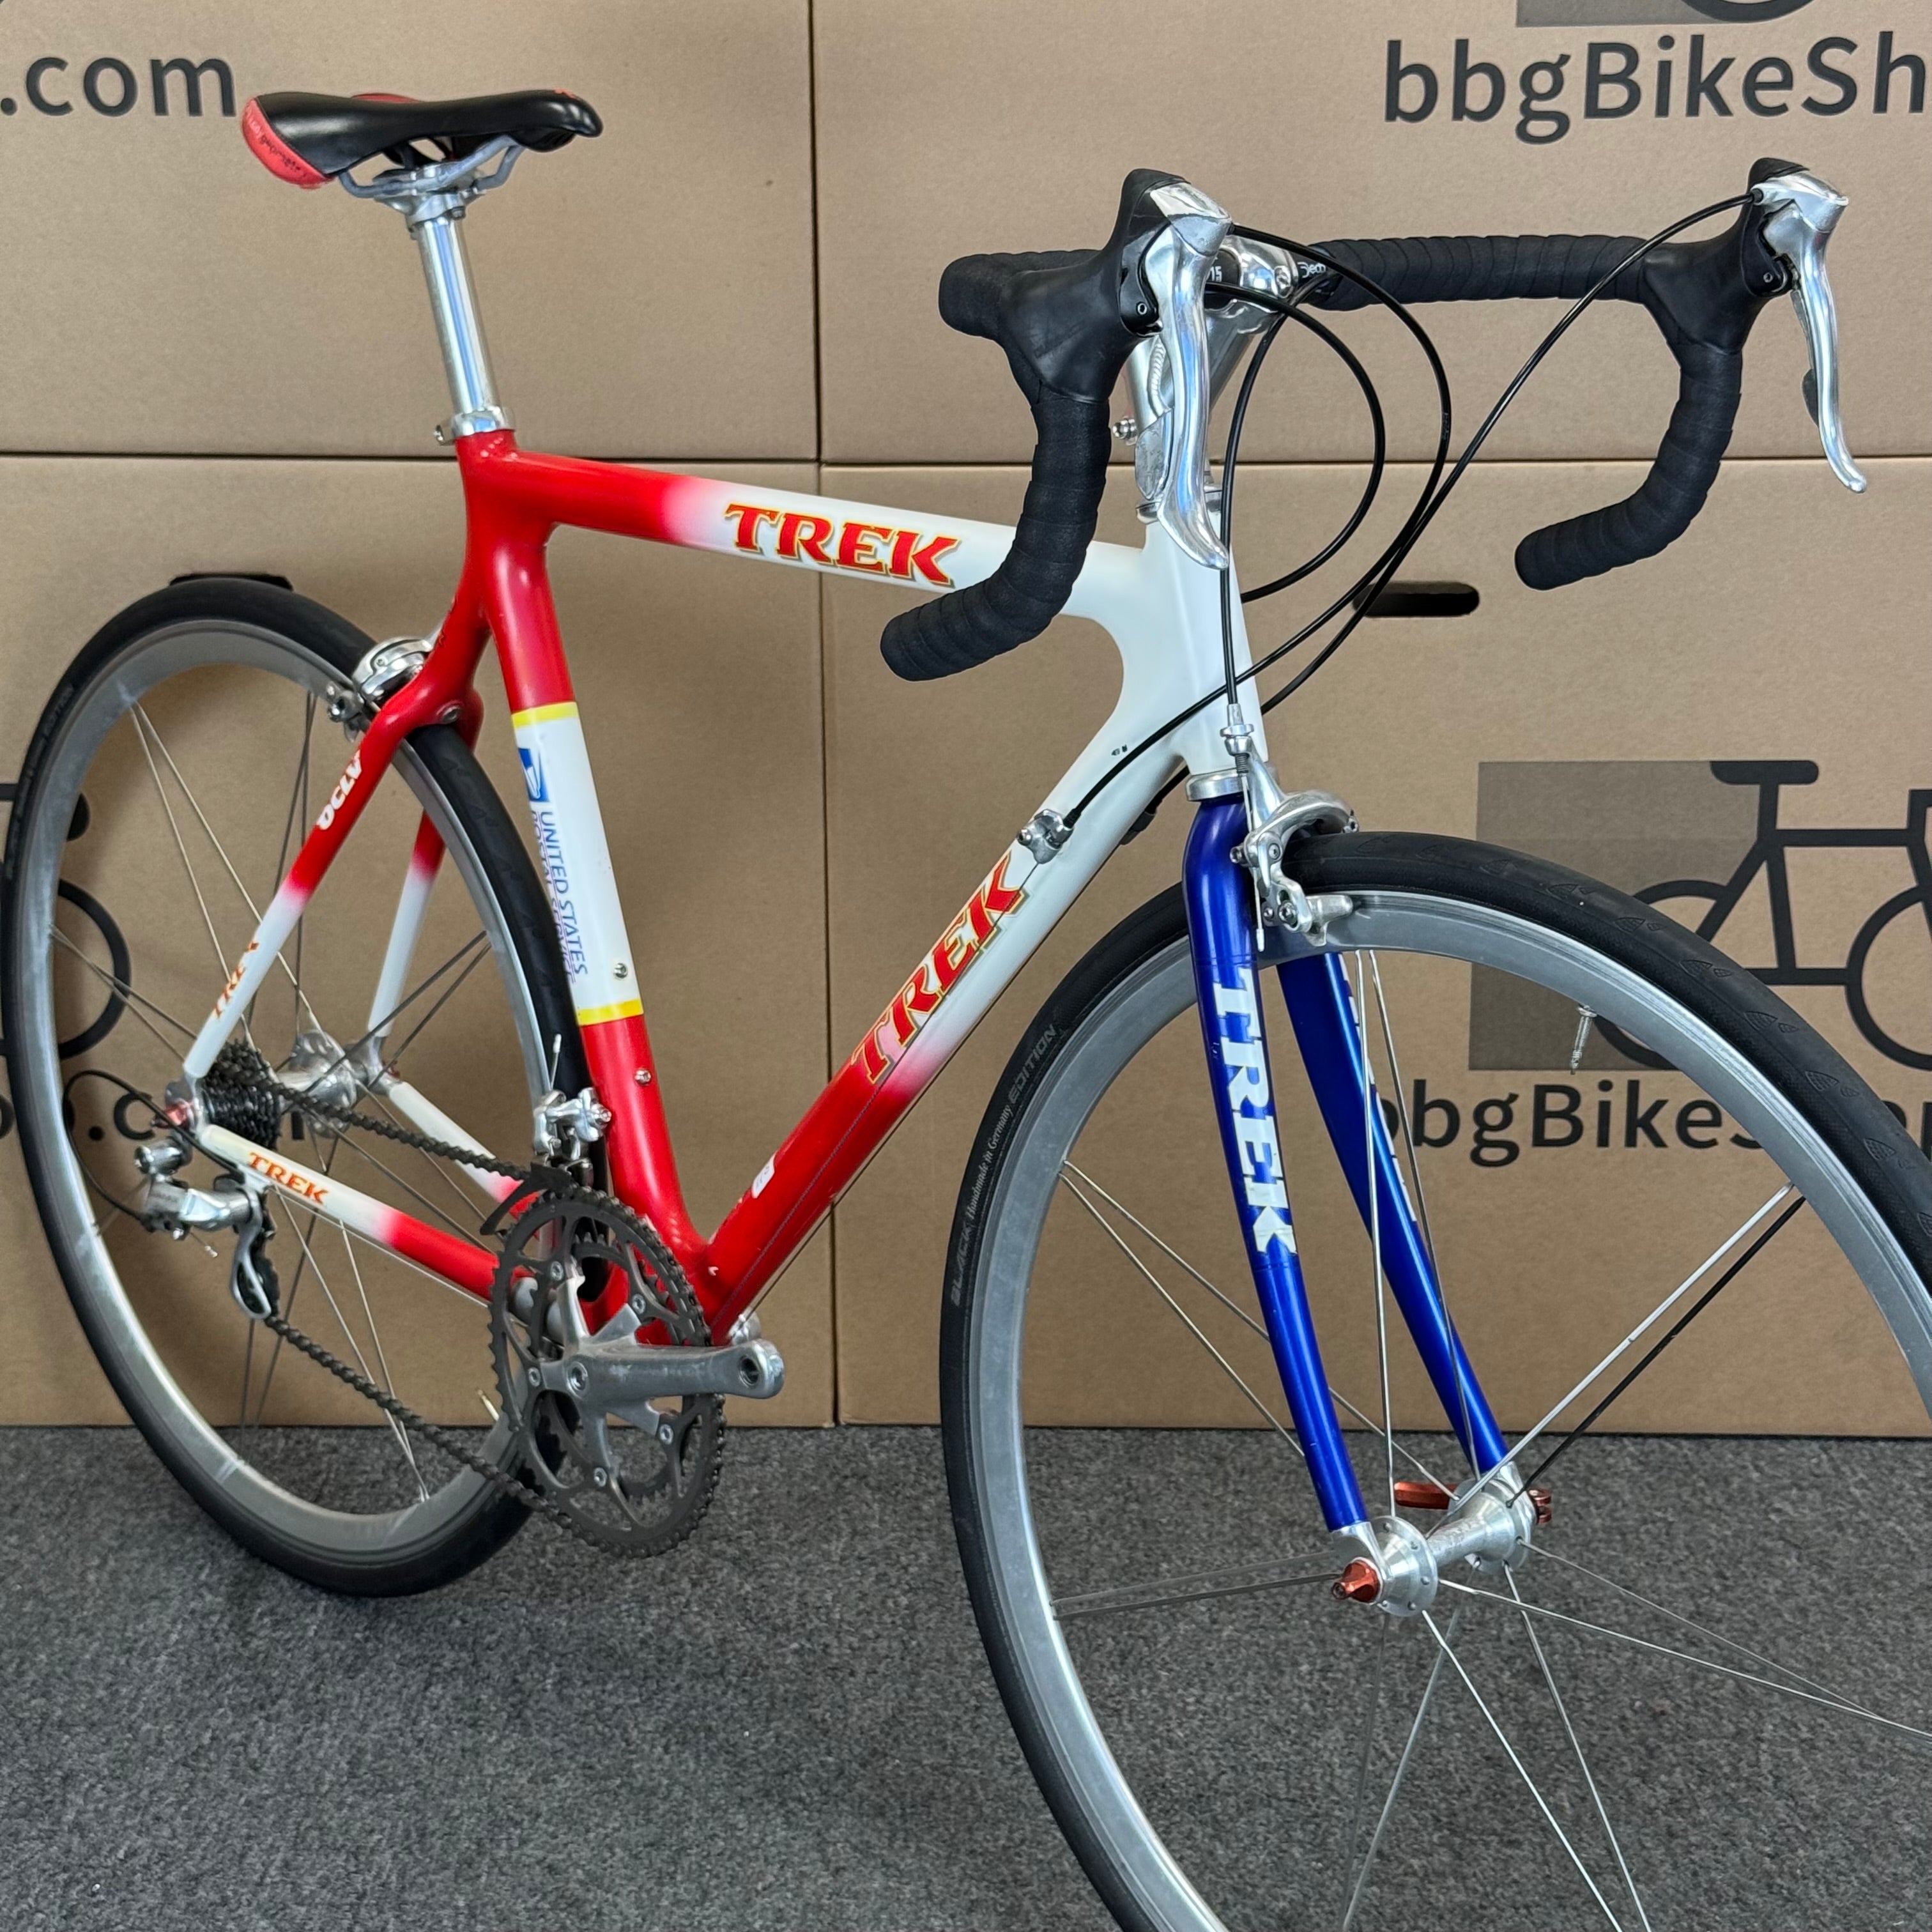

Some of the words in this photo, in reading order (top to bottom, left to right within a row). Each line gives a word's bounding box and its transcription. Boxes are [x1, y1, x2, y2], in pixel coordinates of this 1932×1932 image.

[1, 56, 236, 117] .com
[1385, 31, 1926, 145] bbgBikeSh
[724, 503, 959, 588] TREK
[316, 749, 362, 830] OCLV
[540, 811, 569, 894] UNITED
[559, 900, 588, 976] STATES
[851, 853, 1028, 1084] TREK
[951, 1220, 974, 1307] BLACK
[965, 1163, 988, 1220] Handmade
[983, 1151, 993, 1163] in
[988, 1104, 1014, 1149] Germany
[1008, 1023, 1058, 1104] EDITION
[1213, 967, 1298, 1255] TREK
[249, 1151, 329, 1204] TREK
